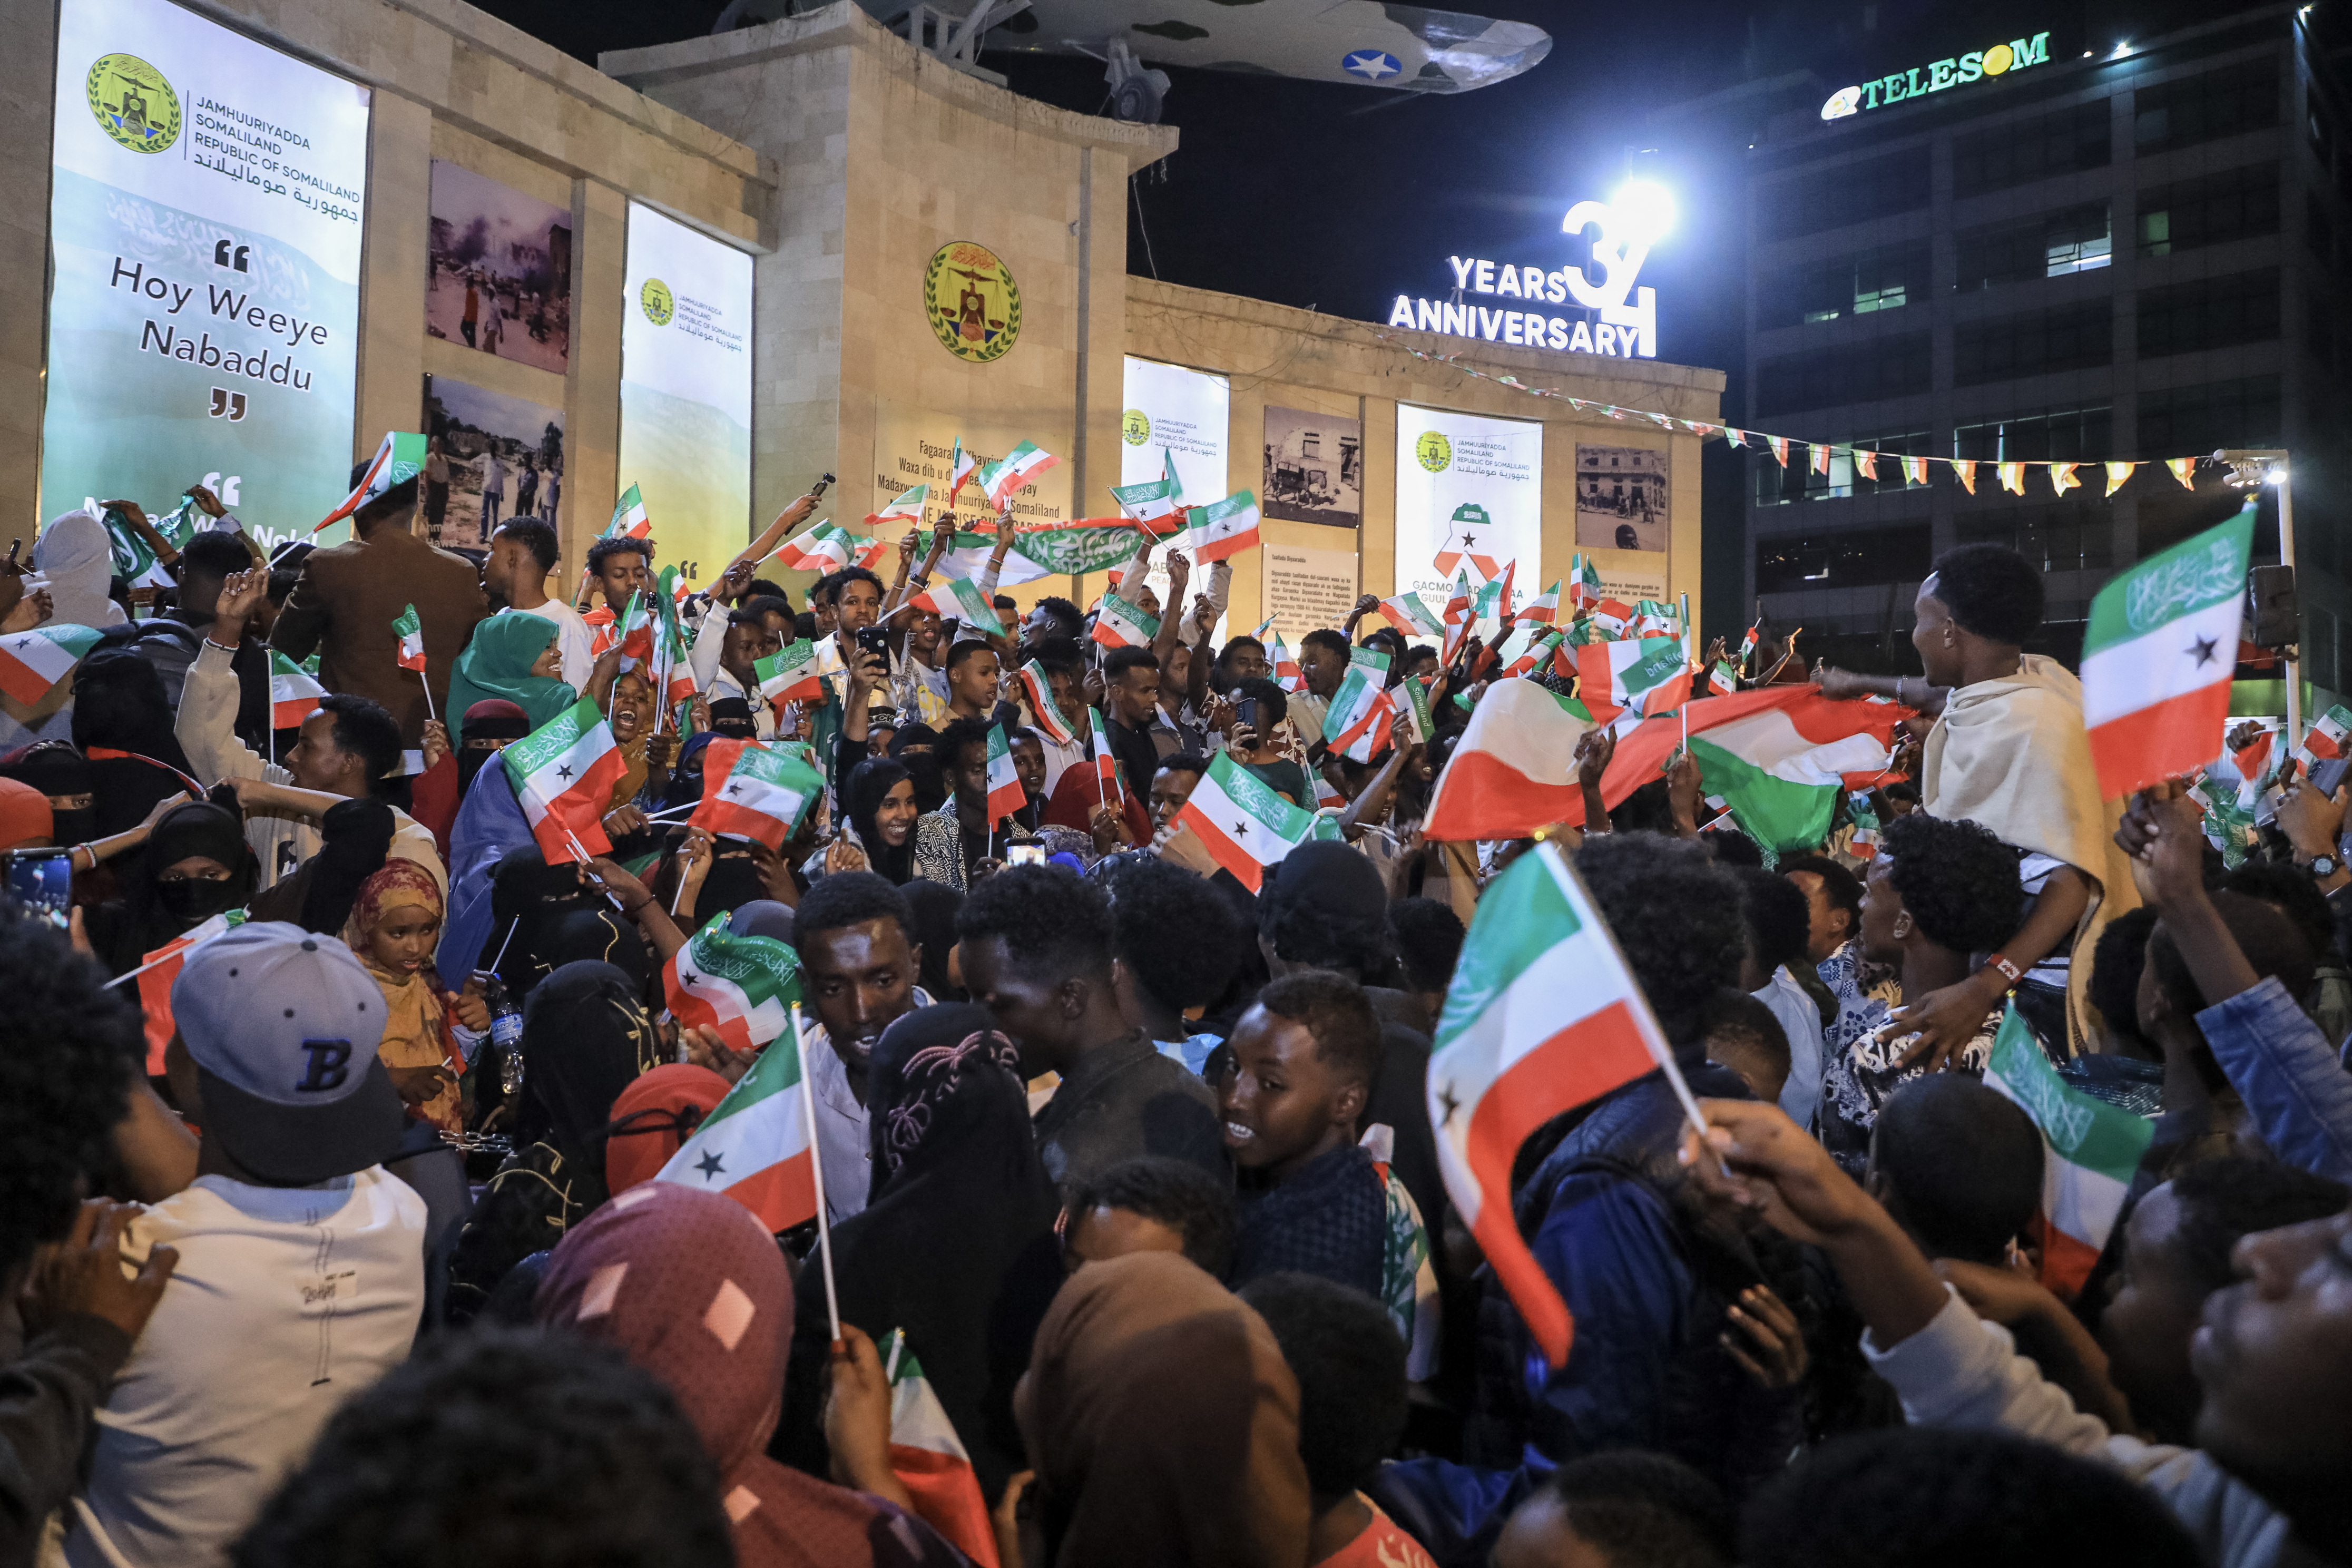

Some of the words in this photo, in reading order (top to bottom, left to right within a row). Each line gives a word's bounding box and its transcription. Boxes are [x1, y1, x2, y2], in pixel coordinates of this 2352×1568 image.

[1861, 32, 2050, 110] TELESOM
[195, 114, 282, 155] SOMALILAND
[197, 97, 311, 150] JAMHUURIYADDA
[195, 132, 258, 165] REPUBLIC
[262, 158, 279, 172] OF
[282, 166, 360, 203] SOMALILAND
[293, 187, 358, 224] جمهورية
[1450, 256, 1567, 303] YEARS
[110, 256, 193, 315] Hoy
[208, 285, 328, 346] Weeye
[679, 303, 711, 320] SOMALILAND
[679, 312, 702, 327] REPUBLIC
[711, 326, 742, 341] SOMALILAND
[1389, 295, 1639, 358] ANNIVERSARY
[140, 319, 312, 391] Nabaddu
[1155, 425, 1186, 435] SOMALILAND
[1155, 433, 1178, 442] REPUBLIC
[1187, 438, 1217, 447] SOMALILAND
[1457, 439, 1506, 451] JAMHUURIYADDA
[919, 440, 954, 460] Fagaara
[1457, 448, 1494, 457] SOMALILAND
[1457, 456, 1484, 465] REPUBLIC
[1494, 461, 1530, 471] SOMALILAND
[899, 457, 919, 474] Waxa
[922, 463, 935, 478] dib
[938, 469, 943, 479] u
[1011, 500, 1060, 518] Somaliland
[1151, 576, 1171, 585] PEAC
[1413, 687, 1430, 727] Somaliland
[296, 1038, 352, 1092] B
